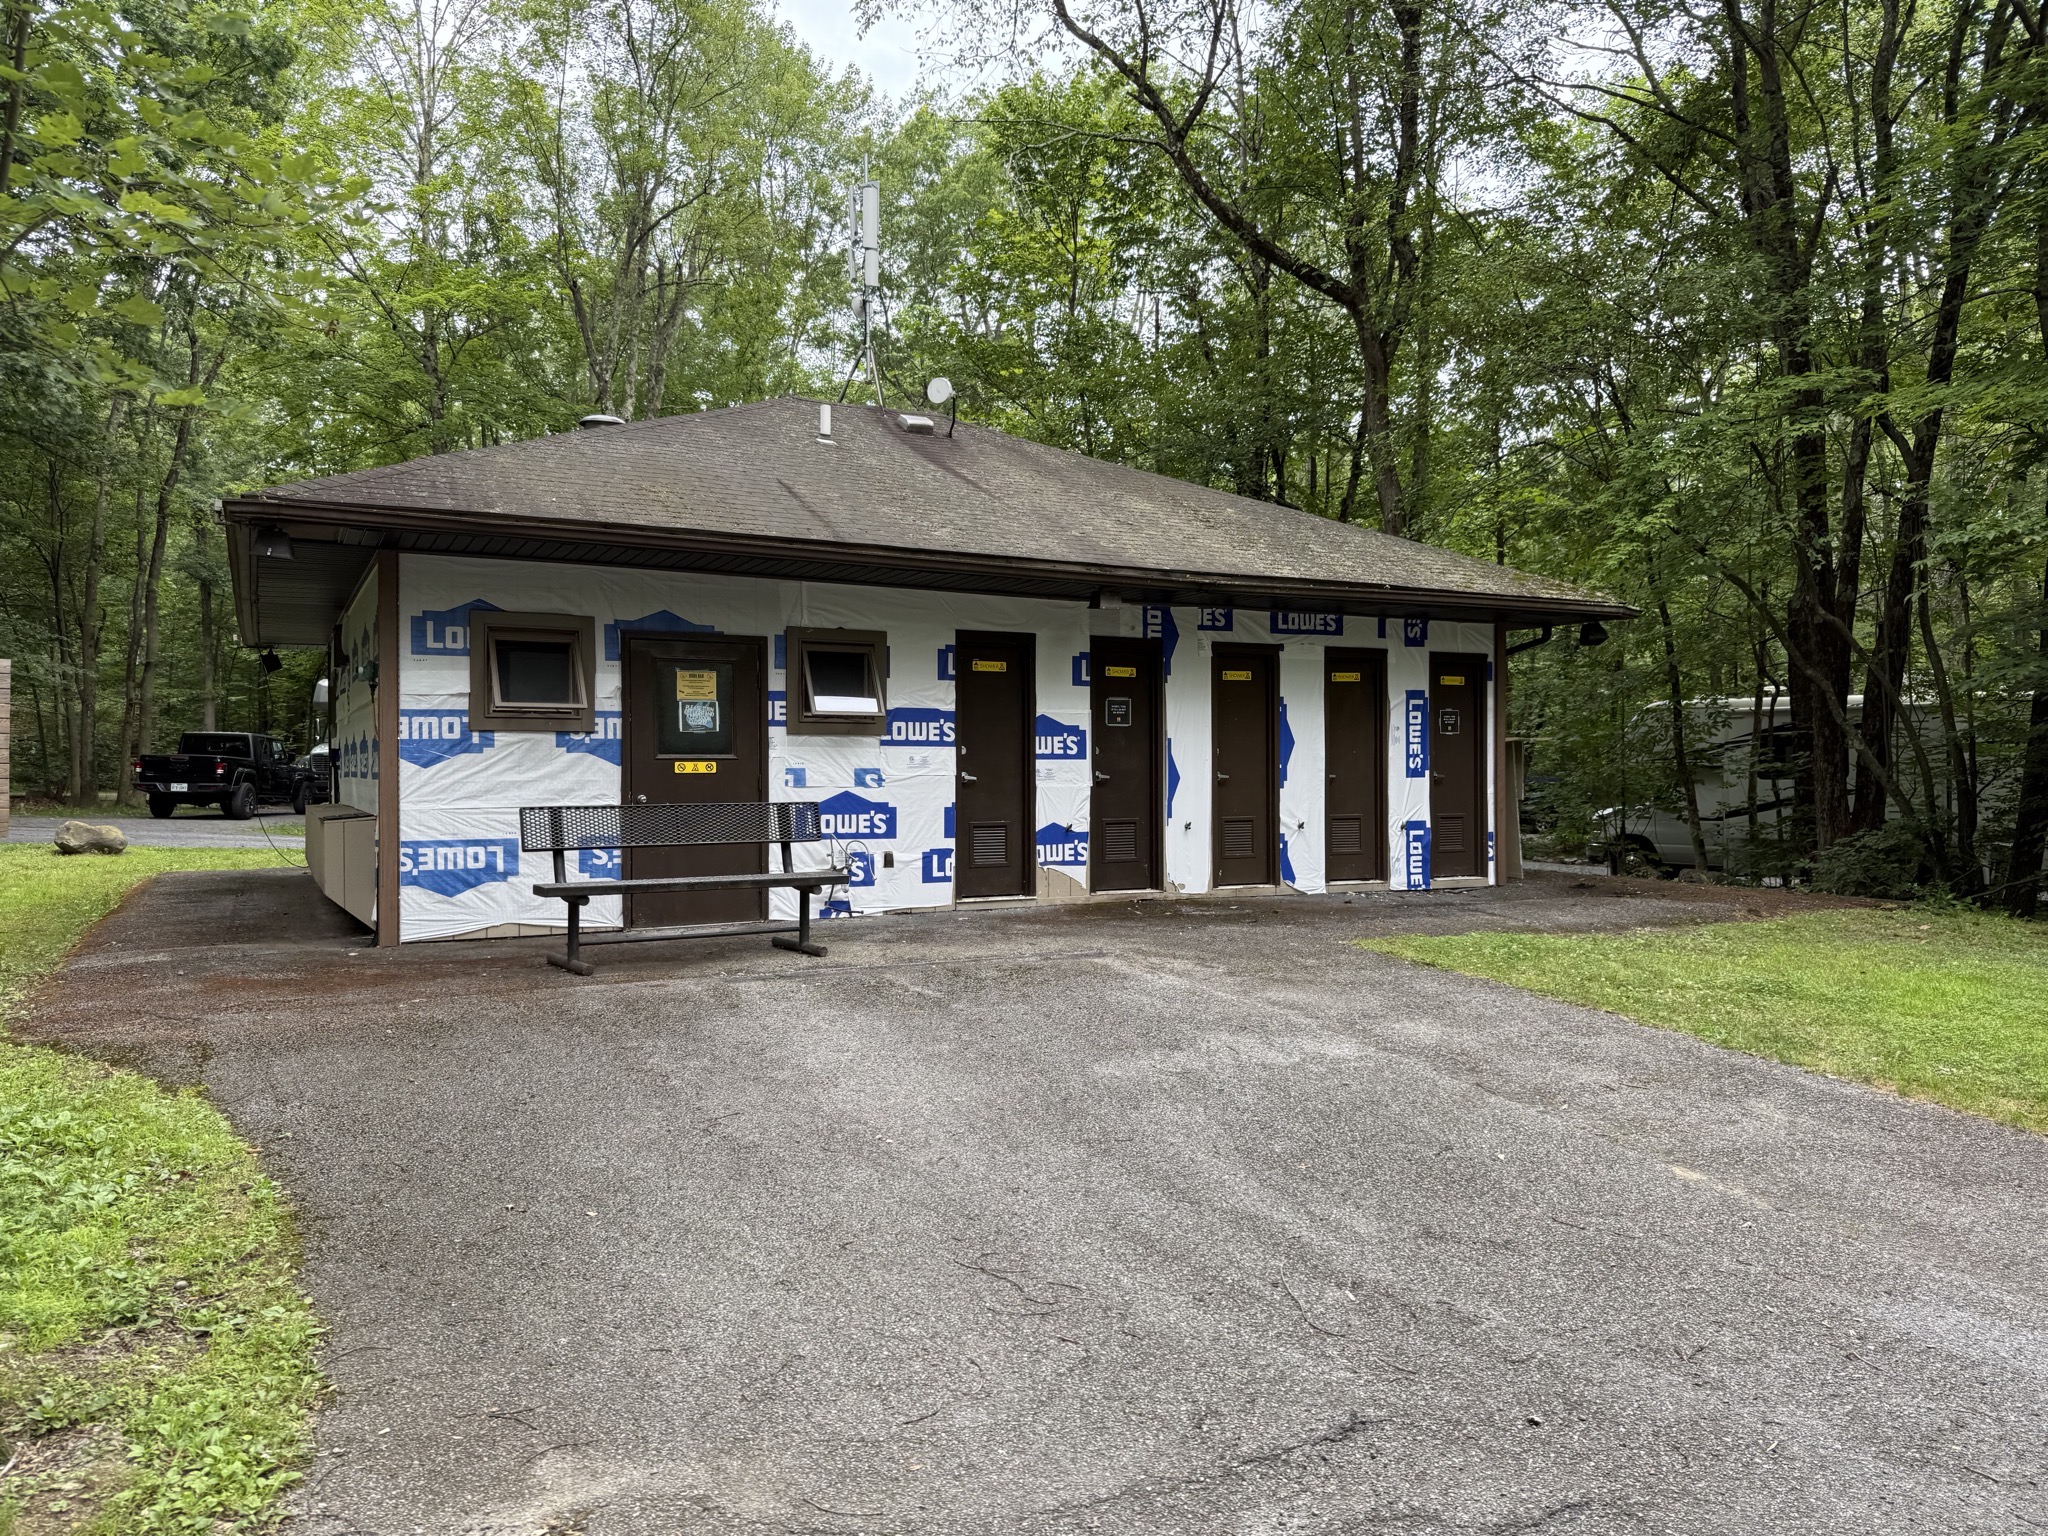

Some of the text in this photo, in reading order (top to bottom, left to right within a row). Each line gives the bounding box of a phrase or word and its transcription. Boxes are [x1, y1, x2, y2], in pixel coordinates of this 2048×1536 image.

[426, 620, 470, 650] LO
[1277, 611, 1337, 632] LOWE'S
[1409, 699, 1424, 770] LOWE'S
[809, 810, 887, 835] OWE'S
[401, 845, 504, 876] LOWE'S
